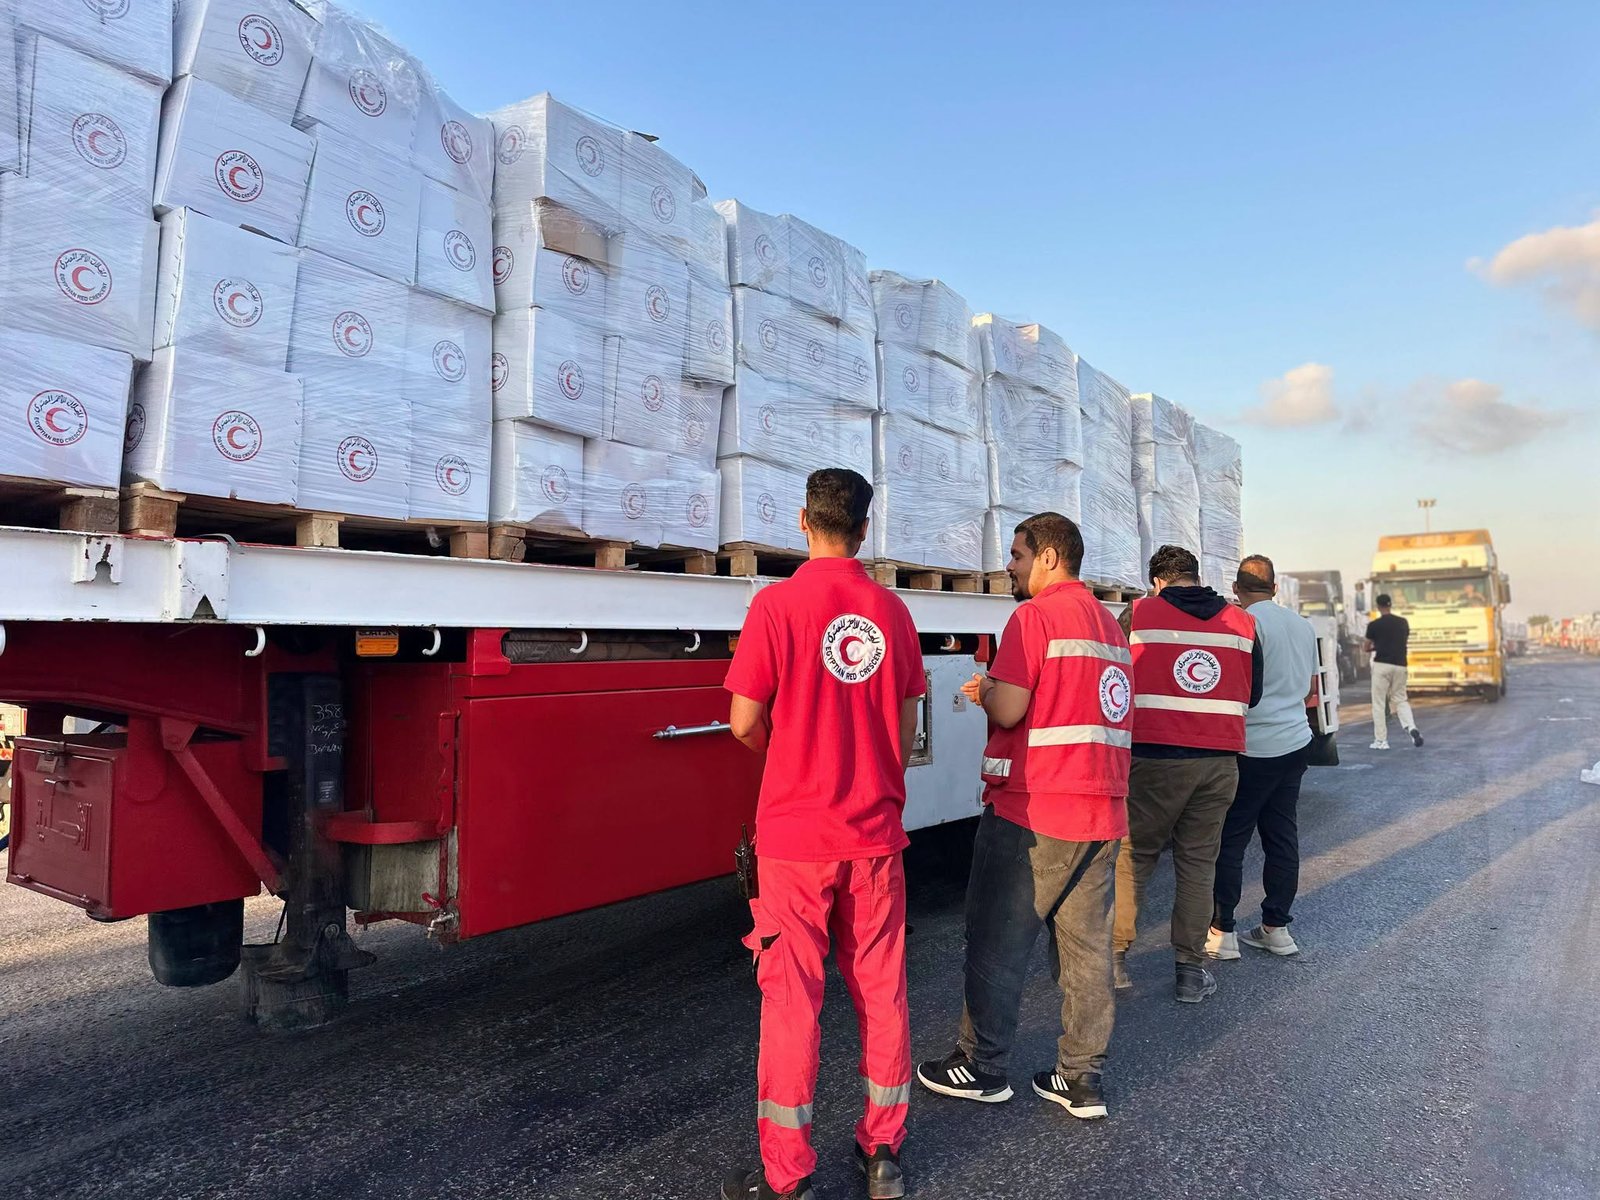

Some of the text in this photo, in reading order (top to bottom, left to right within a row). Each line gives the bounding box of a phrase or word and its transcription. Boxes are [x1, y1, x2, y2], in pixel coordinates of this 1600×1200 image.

[60, 273, 108, 302] EGYPTIAN RED CRESCENT
[34, 416, 84, 444] EGYPTIAN RED CRESCENT
[217, 436, 232, 456] EGYPTIAN
[242, 440, 258, 459] CRESCENT
[860, 621, 880, 644] الهلال
[826, 646, 882, 680] EGYPTIAN RED CRESCENT
[1176, 668, 1192, 690] EGYPTIAN
[1202, 670, 1219, 690] CRESCENT
